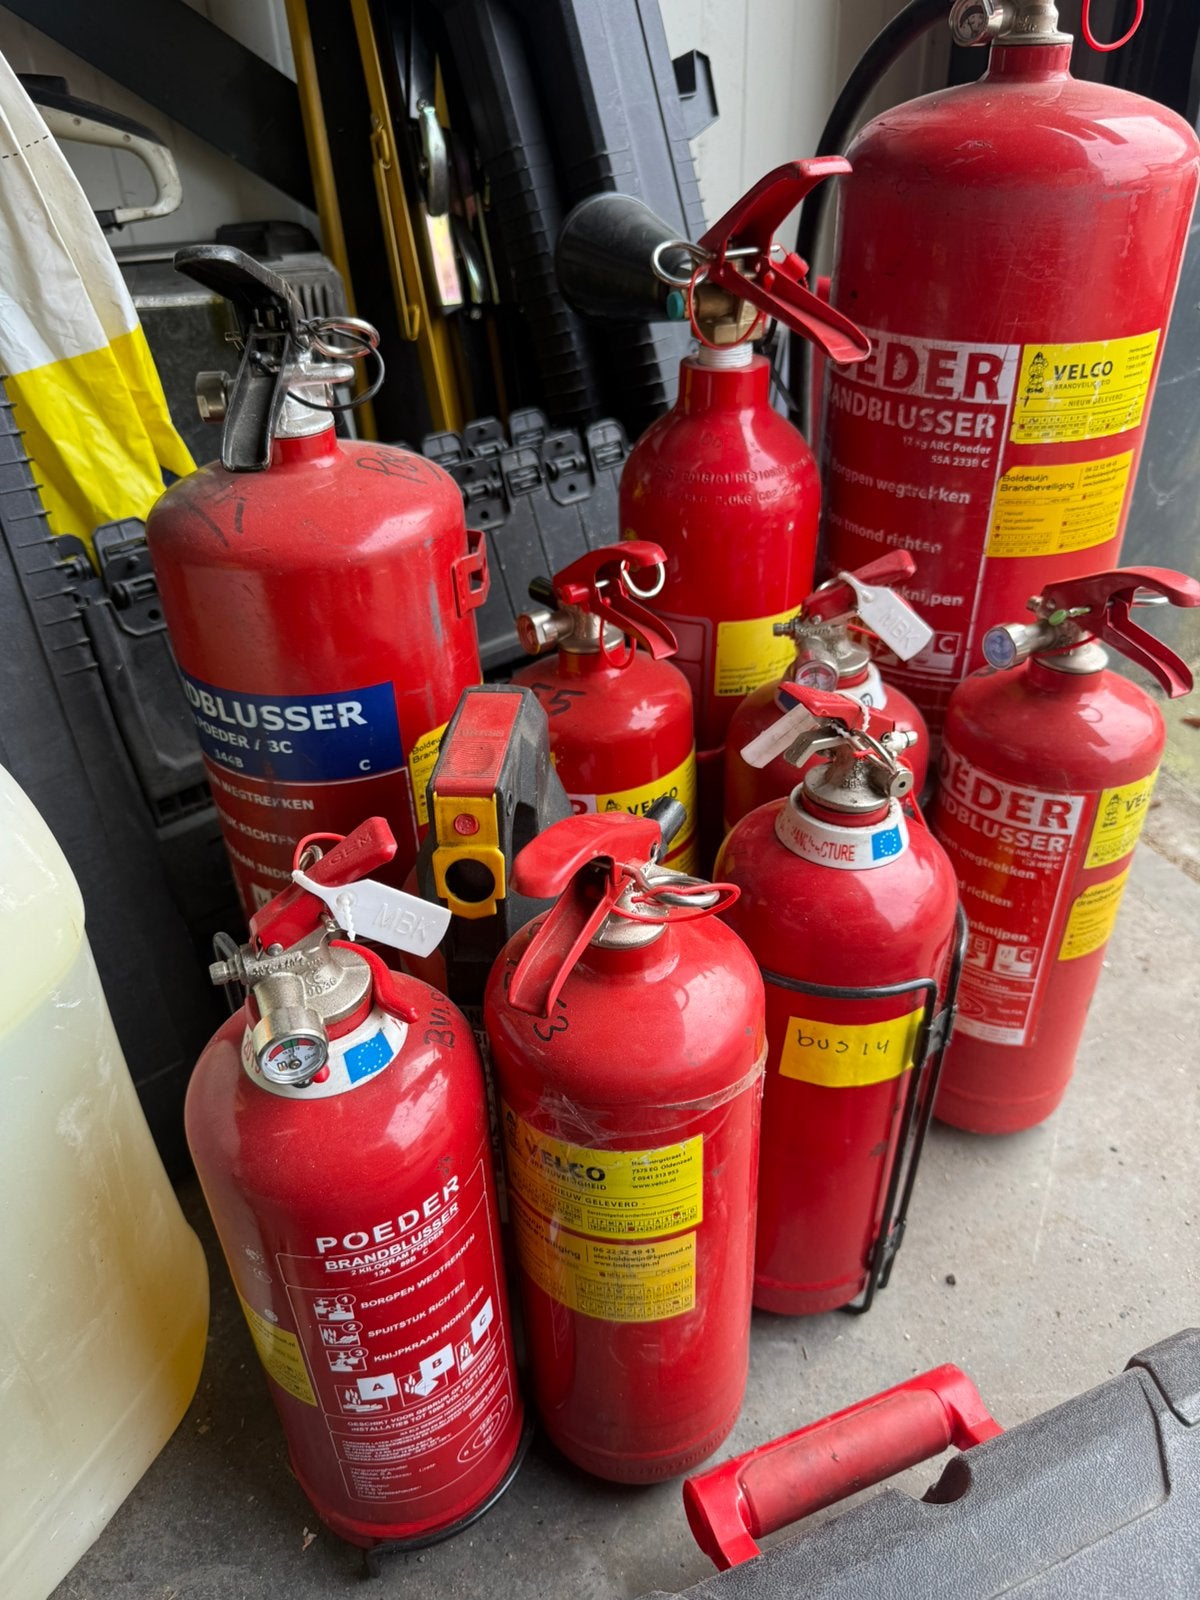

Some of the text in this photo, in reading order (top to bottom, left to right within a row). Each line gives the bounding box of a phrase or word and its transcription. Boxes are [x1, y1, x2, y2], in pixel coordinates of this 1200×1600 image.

[832, 336, 1004, 400] EDER
[1053, 360, 1114, 381] VELCO
[952, 443, 992, 455] Poeder
[981, 459, 990, 468] C
[876, 479, 971, 505] wegtrekken
[266, 740, 294, 755] 3C
[358, 759, 371, 771] C
[862, 1039, 890, 1056] 14
[315, 1174, 460, 1254] POEDER
[584, 1197, 639, 1208] GELEVERD
[324, 1201, 459, 1271] BRANDBLUSSER
[359, 1251, 410, 1275] KILOGRAM
[411, 1228, 445, 1255] POEDER
[360, 1284, 415, 1309] BORGPEN
[416, 1233, 475, 1289] WEGTREKKEN
[367, 1310, 427, 1338] SPUITSTUK
[428, 1279, 466, 1314] RICHTEN
[373, 1329, 440, 1363] KNIJPKRAAN
[372, 1382, 385, 1391] A
[431, 1357, 443, 1369] B
[390, 1412, 415, 1424] VOOR
